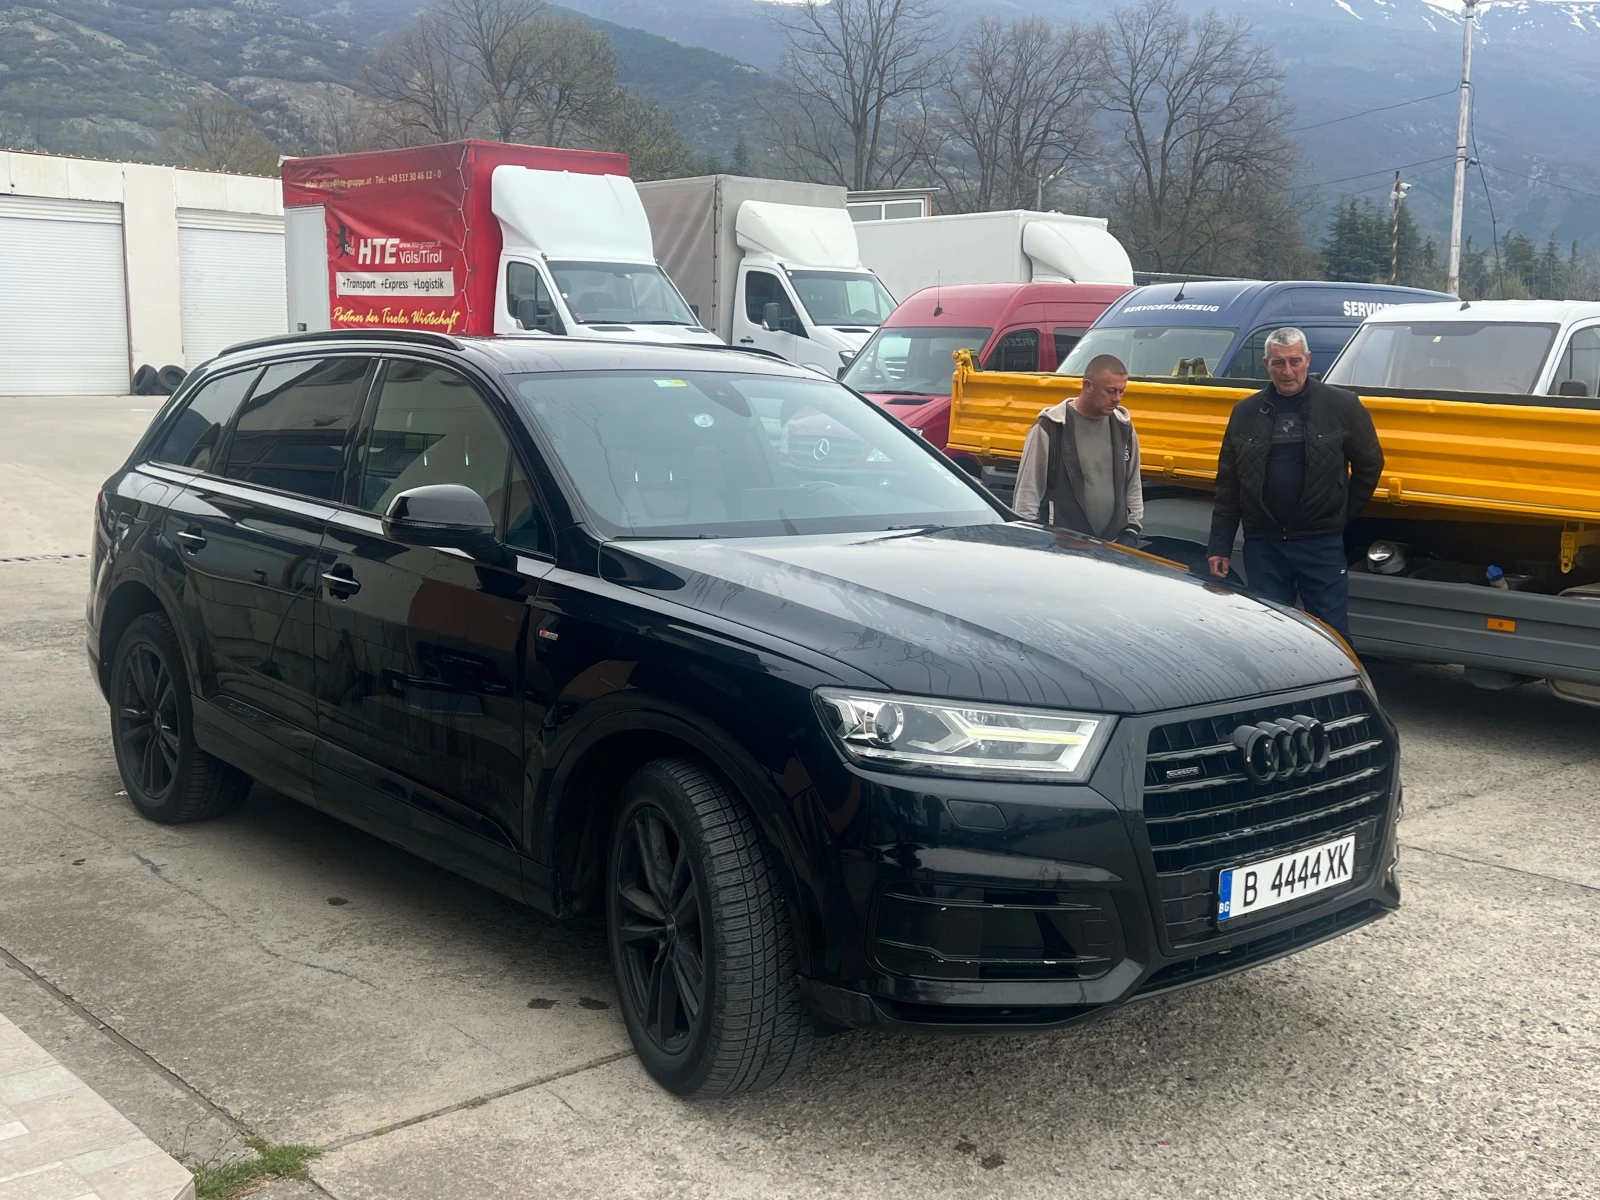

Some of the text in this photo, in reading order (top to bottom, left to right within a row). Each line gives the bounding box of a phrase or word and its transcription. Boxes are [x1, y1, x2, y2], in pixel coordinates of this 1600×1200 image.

[409, 172, 417, 181] 30
[417, 171, 425, 180] 46
[425, 170, 433, 180] 12
[358, 238, 400, 264] HTE
[1122, 303, 1220, 314] SERVICEFAHRZEUG
[1343, 300, 1396, 317] SERVIC
[333, 306, 461, 334] Partner der Tiroler Wirtschaft
[1243, 842, 1351, 908] B 4444 XK
[1218, 901, 1230, 914] BG
